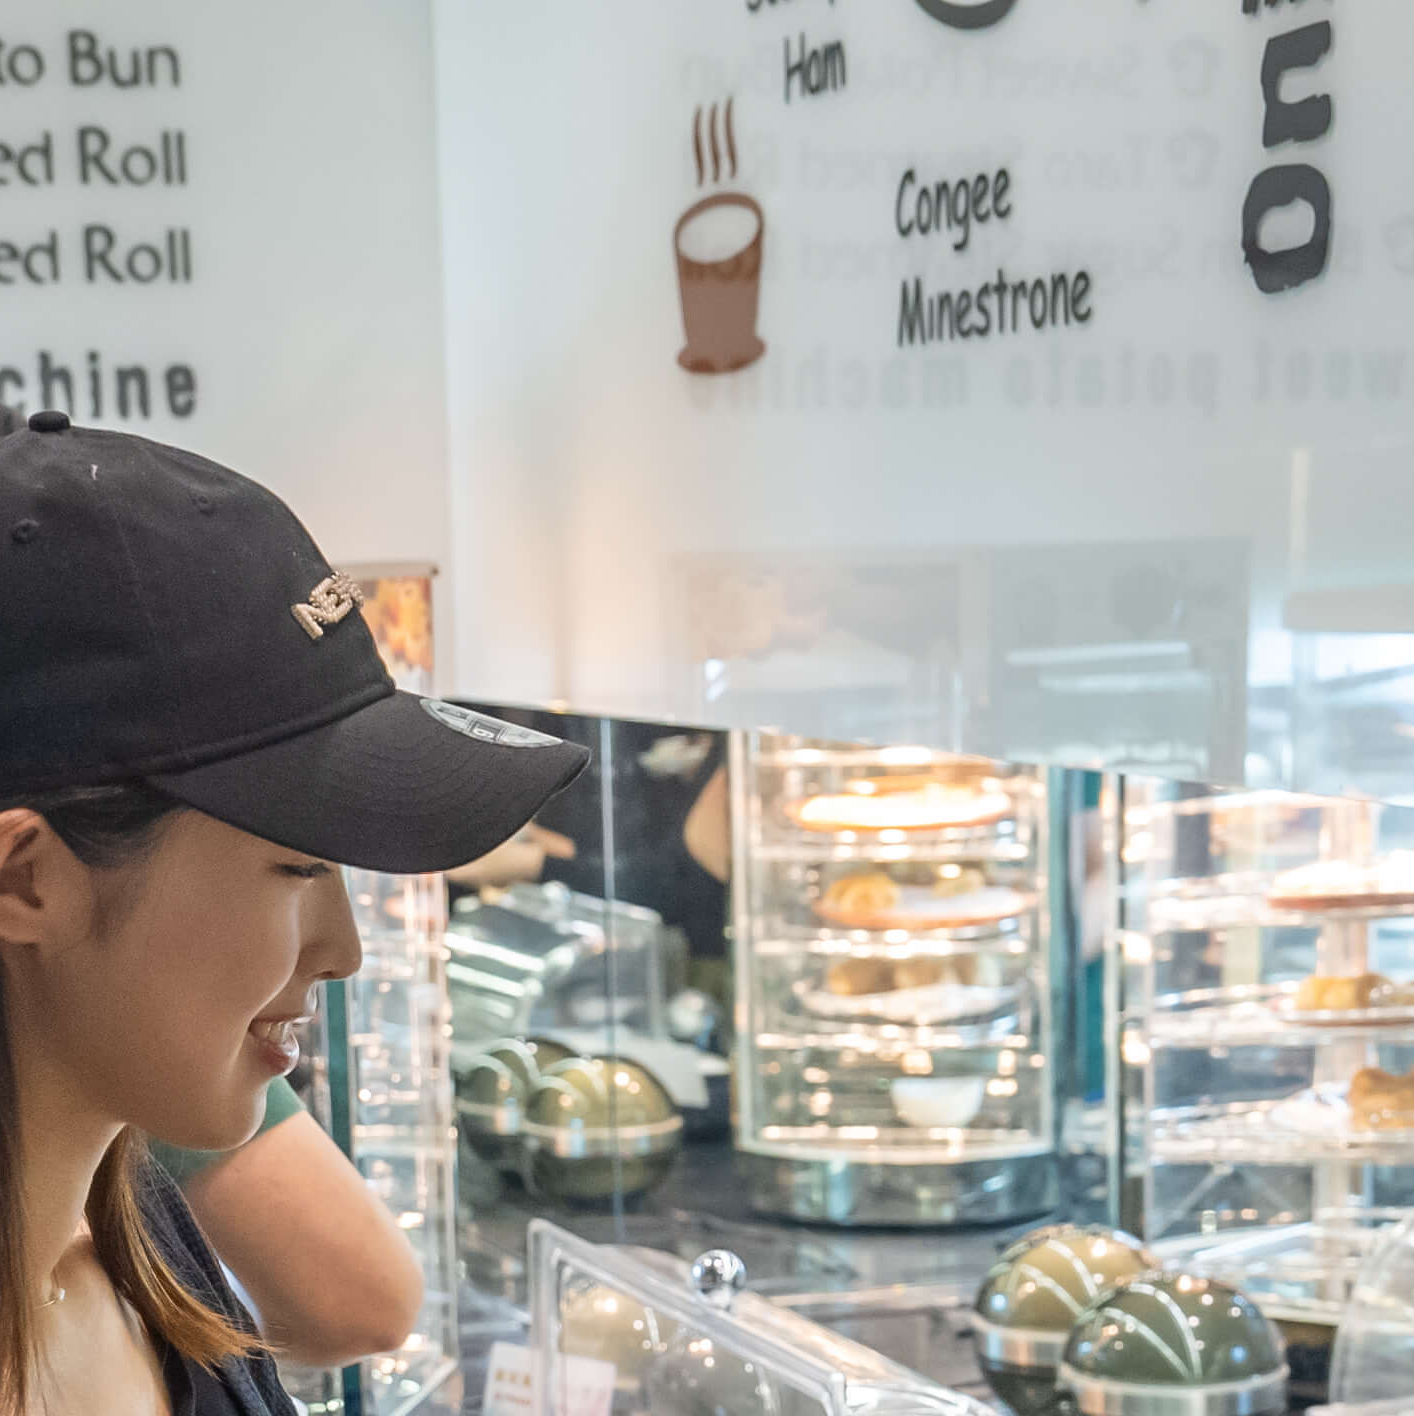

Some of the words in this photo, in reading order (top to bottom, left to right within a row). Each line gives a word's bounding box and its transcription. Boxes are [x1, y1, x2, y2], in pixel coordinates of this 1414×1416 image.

[66, 30, 181, 89] Bun
[783, 32, 847, 104] Ham
[76, 125, 188, 187] Roll
[895, 167, 1012, 253] Congee
[83, 224, 192, 285] Roll
[897, 268, 1093, 347] Minestrone
